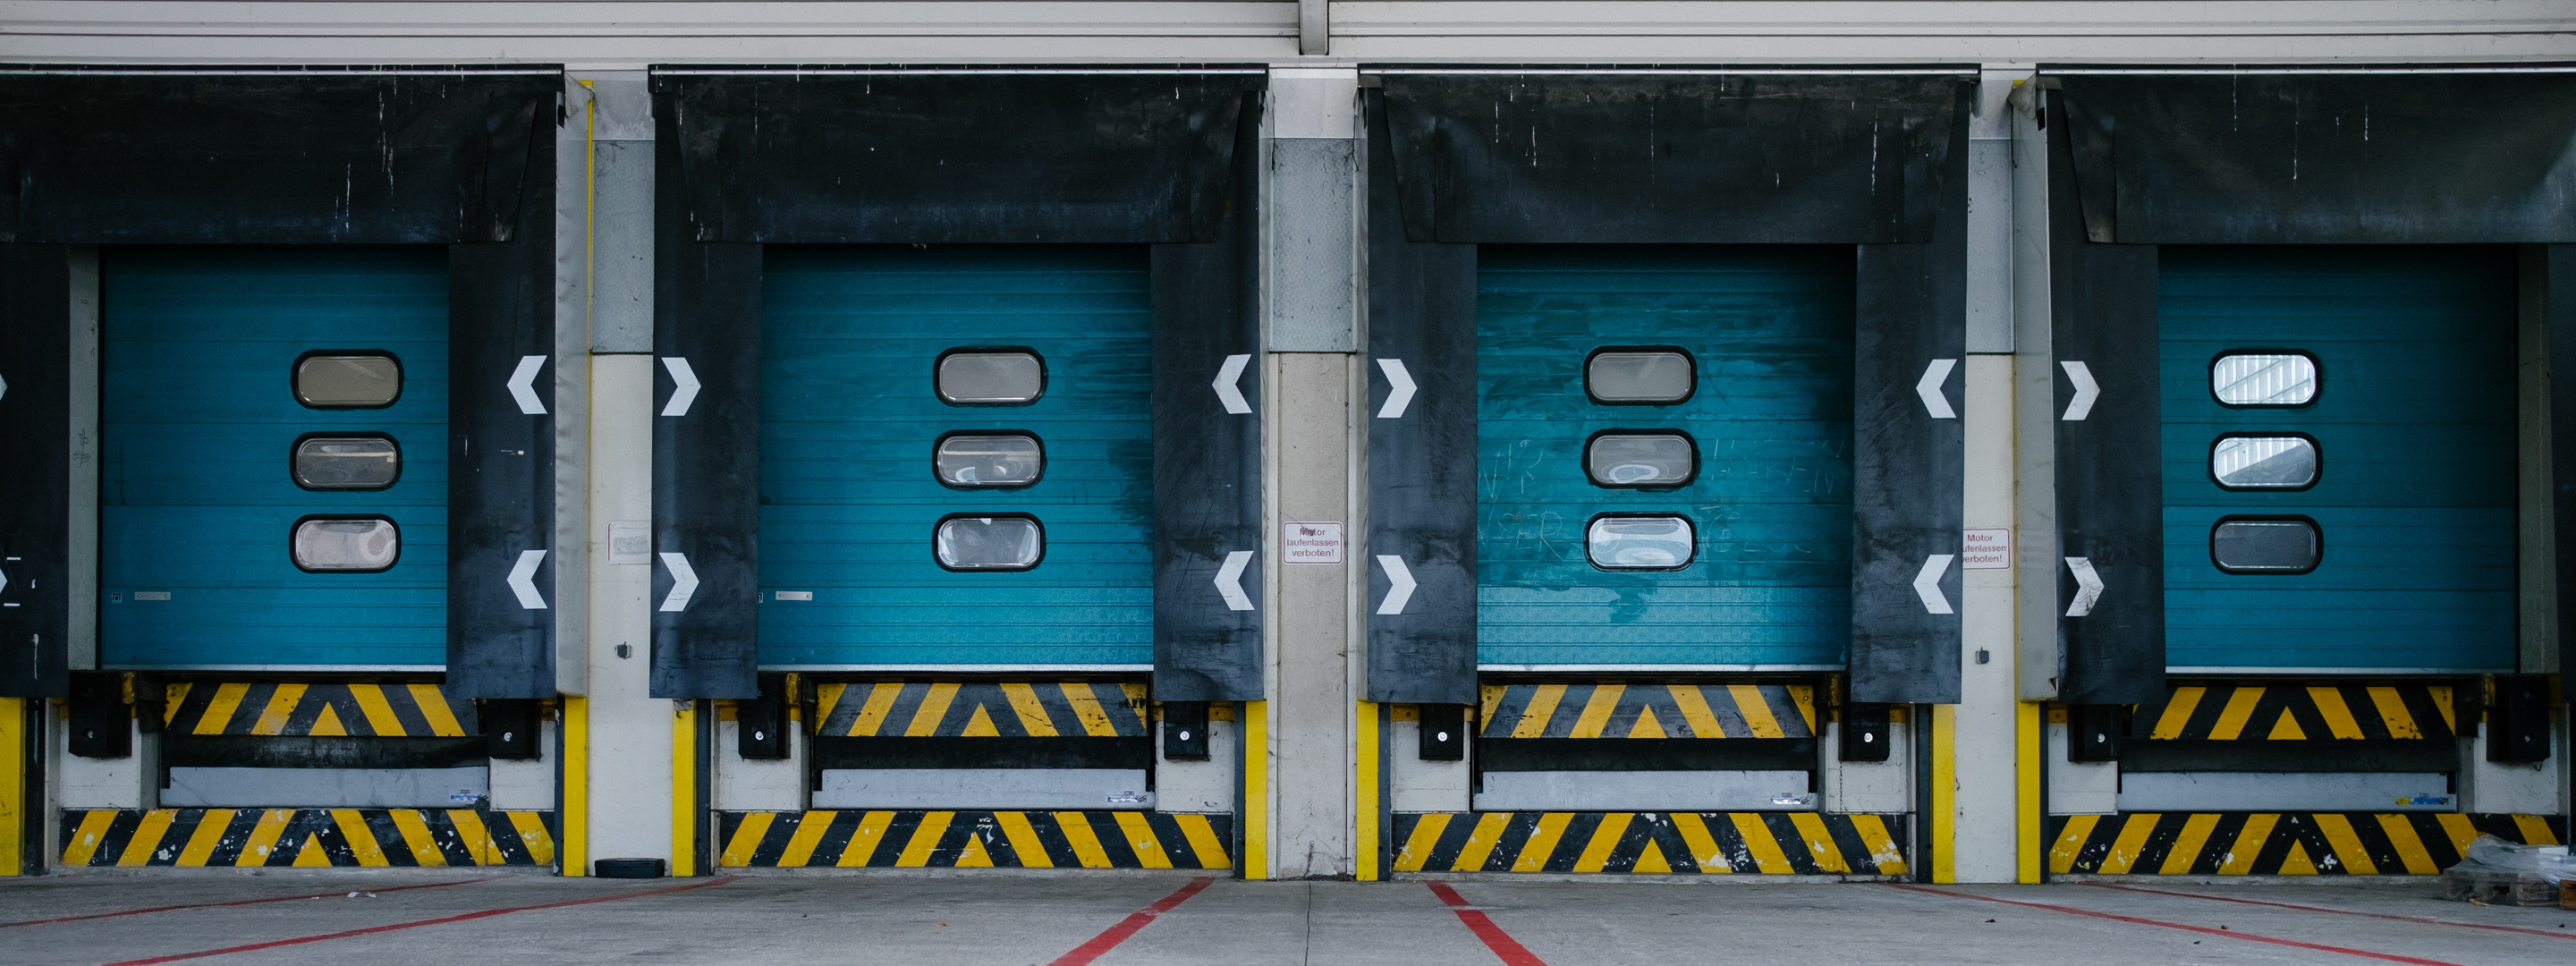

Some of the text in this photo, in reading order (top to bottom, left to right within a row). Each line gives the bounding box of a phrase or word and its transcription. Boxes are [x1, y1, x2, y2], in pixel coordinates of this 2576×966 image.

[1300, 528, 1326, 536] Mtor
[1967, 534, 1993, 542] Motor
[1286, 538, 1339, 547] laufenlassen
[1292, 548, 1335, 556] verboten!
[1963, 544, 2006, 553] ufenlassen
